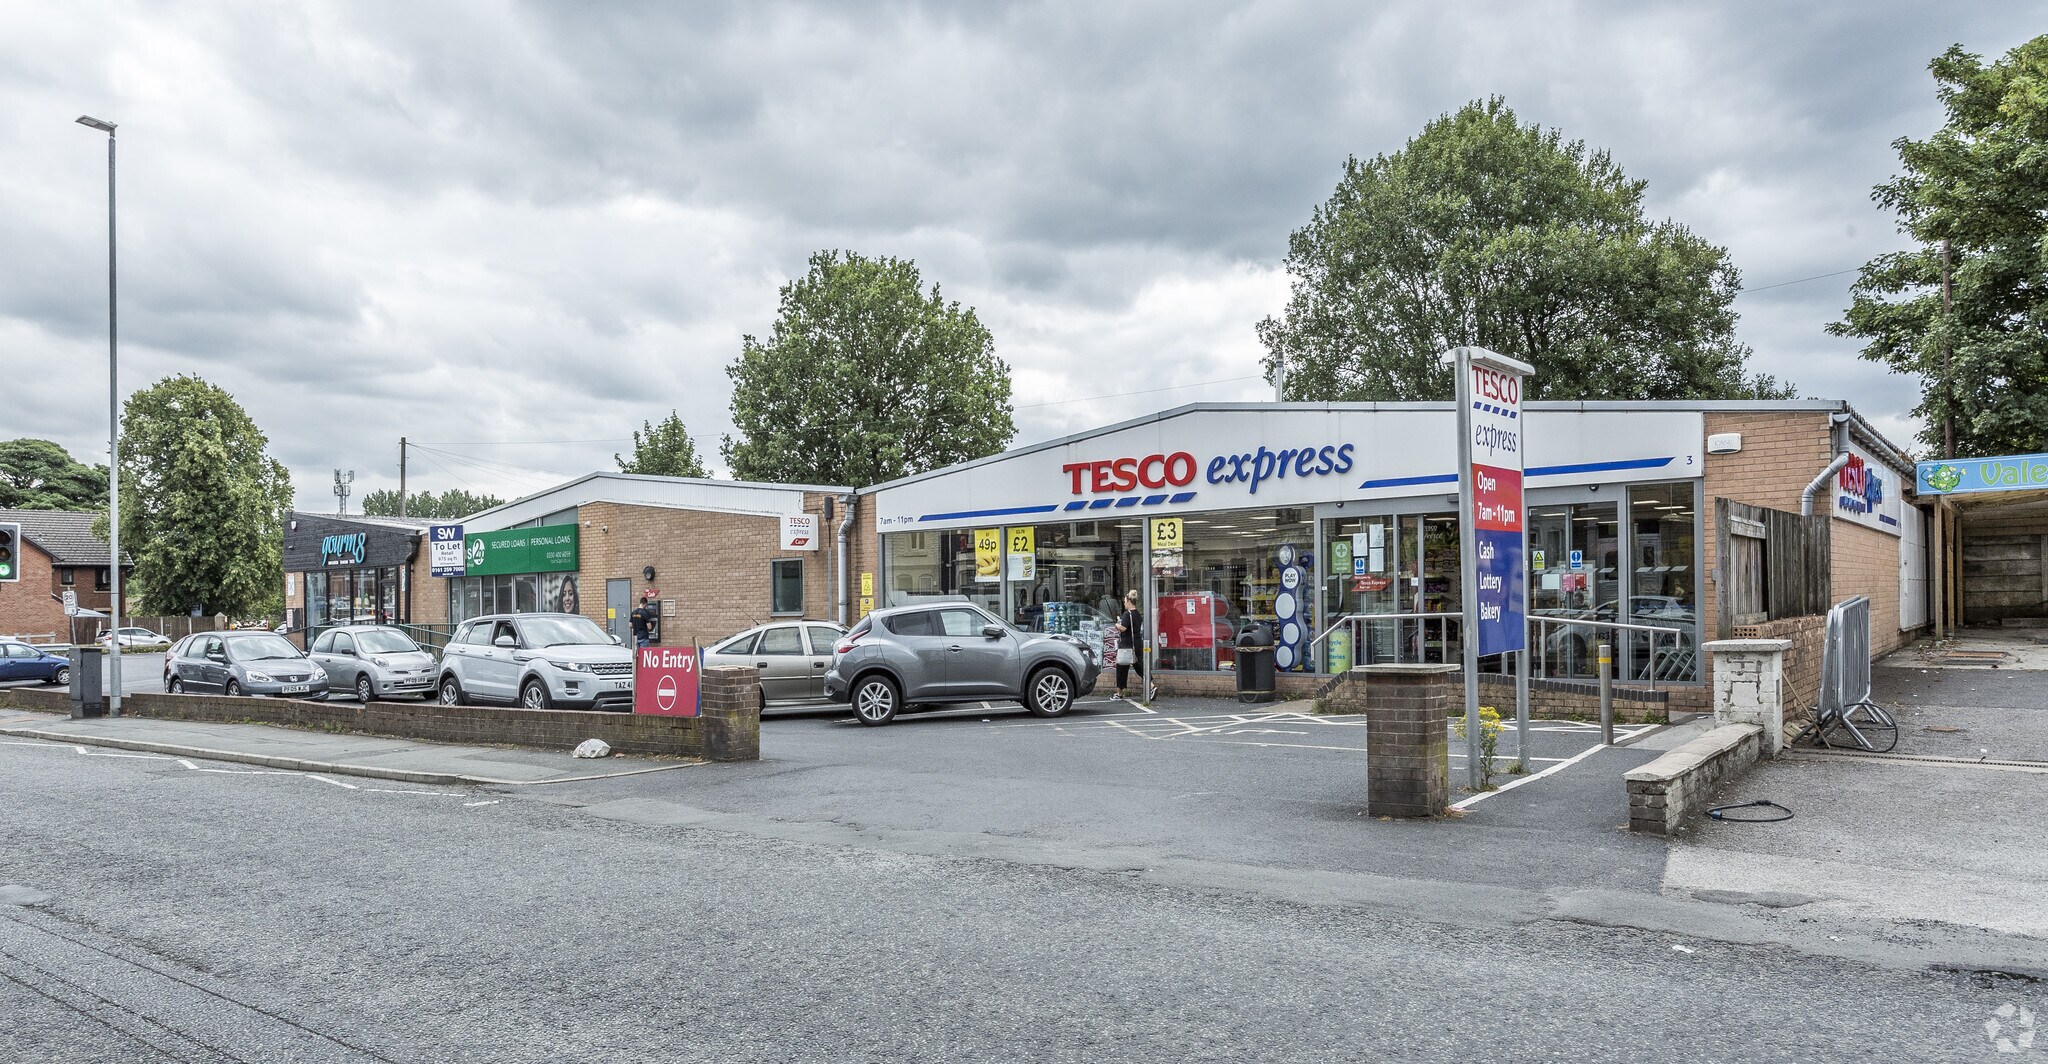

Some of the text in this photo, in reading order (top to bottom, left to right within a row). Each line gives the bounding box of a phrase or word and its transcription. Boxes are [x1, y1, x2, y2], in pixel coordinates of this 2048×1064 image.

[1472, 365, 1518, 404] TESCO
[1476, 424, 1516, 456] express
[1062, 444, 1354, 494] TESCO express
[1686, 456, 1693, 465] 3
[1478, 471, 1496, 494] Open
[437, 528, 455, 540] SW
[1157, 522, 1177, 540] £3
[492, 535, 571, 549] SECURED LOANS PERSONAL LOANS
[979, 539, 997, 552] 49p
[1013, 536, 1028, 551] £2
[1479, 541, 1494, 560] Cash
[1480, 572, 1502, 593] Lottery
[1480, 602, 1501, 623] Bakery
[643, 650, 694, 672] No Entry
